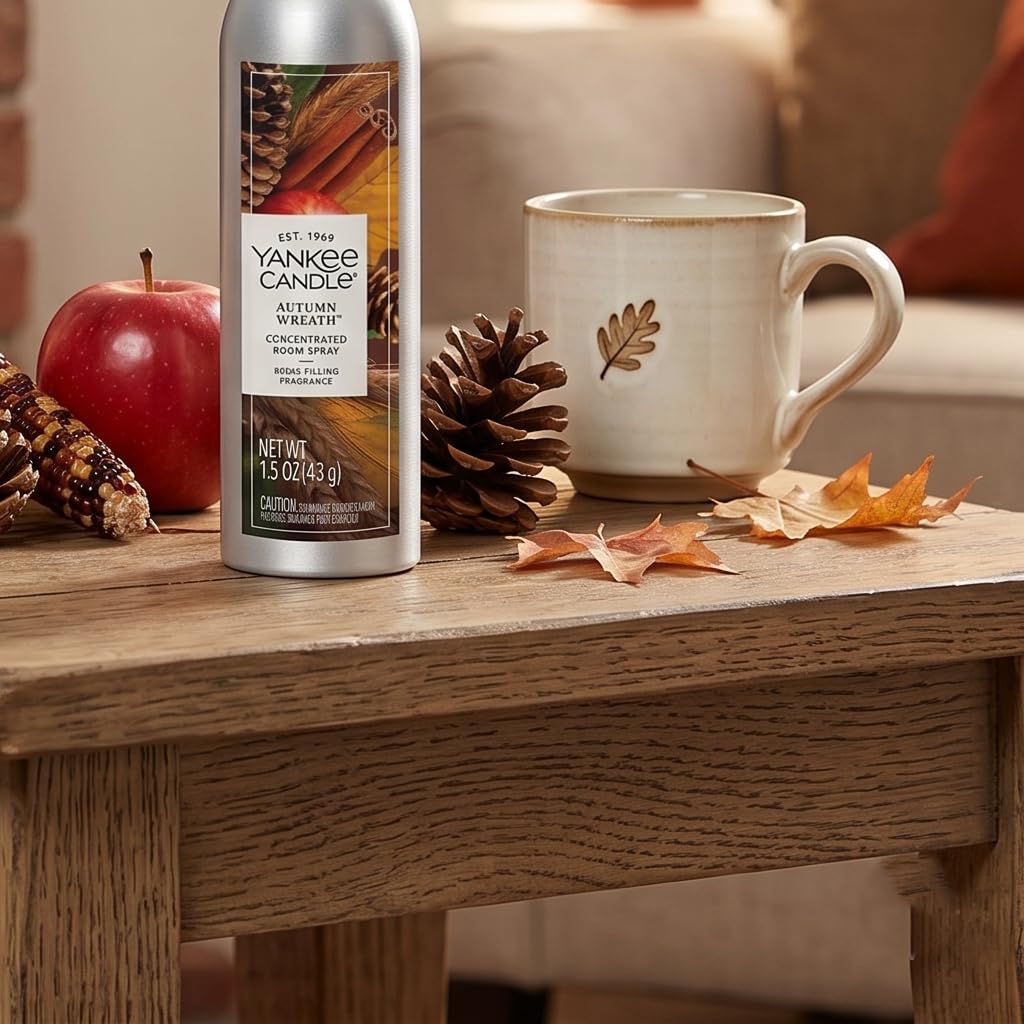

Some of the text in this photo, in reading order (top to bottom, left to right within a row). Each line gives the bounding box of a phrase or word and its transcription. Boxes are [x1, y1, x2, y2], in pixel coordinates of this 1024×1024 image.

[278, 231, 335, 243] EST. 1969
[276, 302, 337, 313] AUTUMN
[272, 346, 340, 356] ROOM SPRAY
[304, 367, 339, 376] FILLING
[258, 438, 308, 460] NET WT
[259, 460, 279, 481] 1.5
